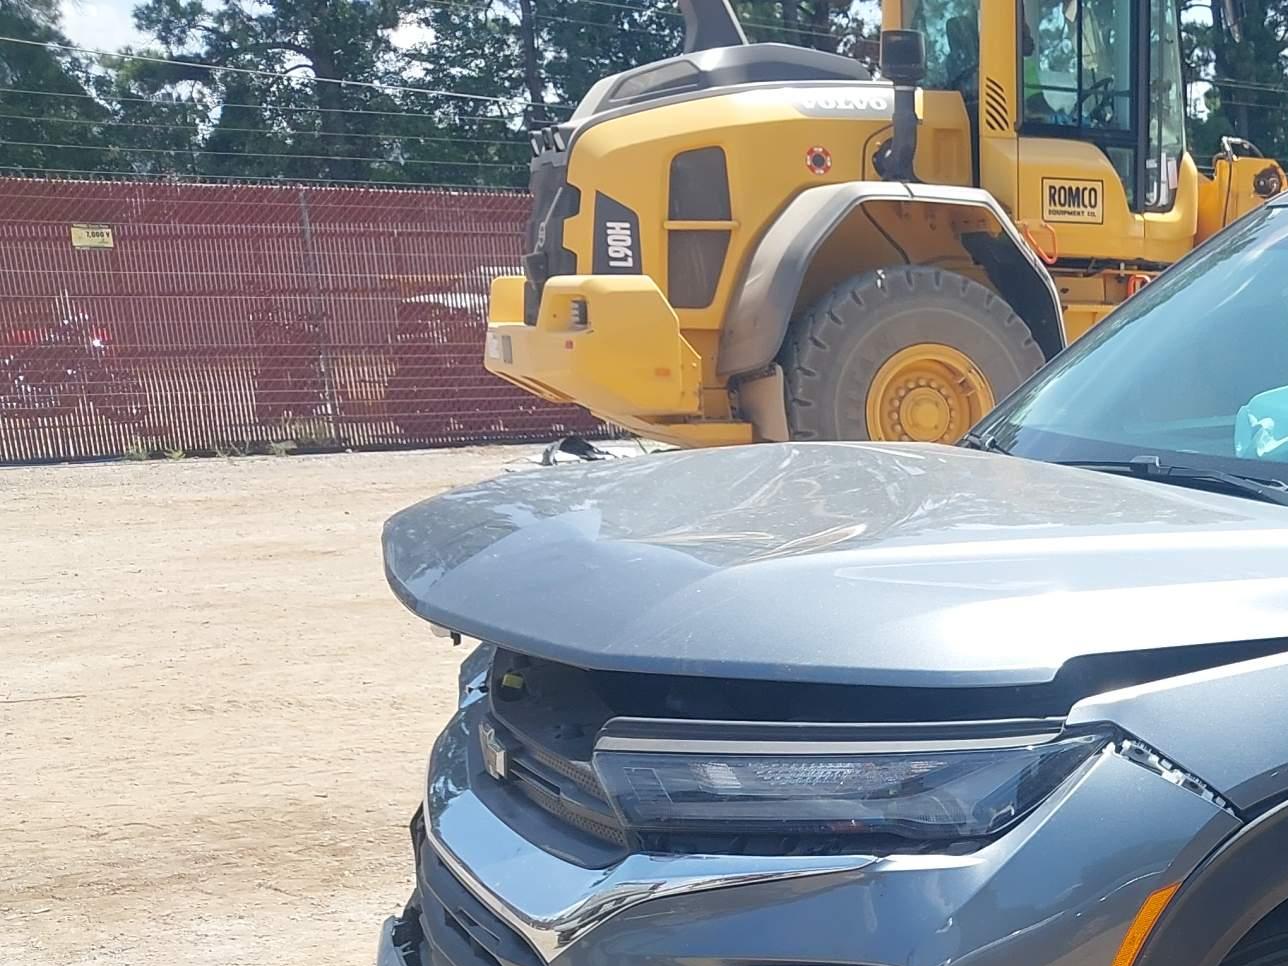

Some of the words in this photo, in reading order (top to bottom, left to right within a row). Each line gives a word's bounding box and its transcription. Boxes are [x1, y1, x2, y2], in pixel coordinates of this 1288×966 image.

[802, 96, 888, 110] VOLVO
[1048, 185, 1098, 209] ROMCO
[86, 231, 104, 239] 7,000
[605, 221, 633, 267] L90H
